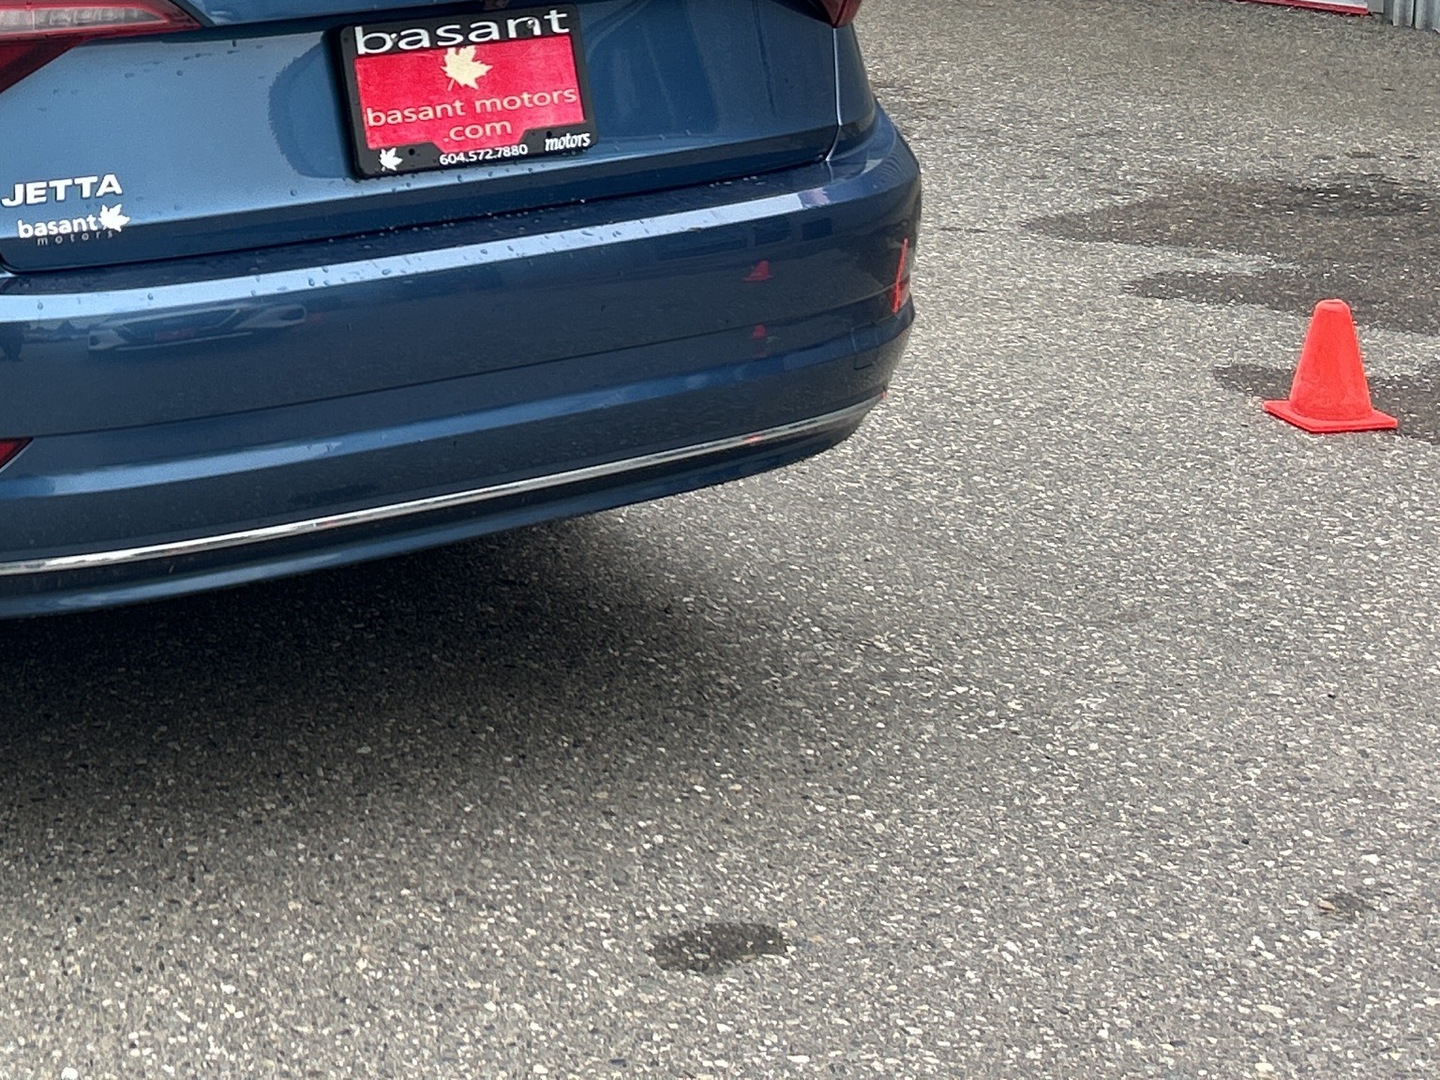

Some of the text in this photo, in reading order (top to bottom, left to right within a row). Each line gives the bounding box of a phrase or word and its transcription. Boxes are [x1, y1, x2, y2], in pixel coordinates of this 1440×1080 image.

[354, 9, 570, 55] basant
[366, 88, 578, 127] basant motors
[443, 120, 513, 143] .com
[544, 131, 592, 152] motors
[439, 143, 529, 166] 604.572.7880
[1, 173, 123, 208] JETTA
[17, 214, 99, 239] basant
[37, 229, 113, 246] motors
